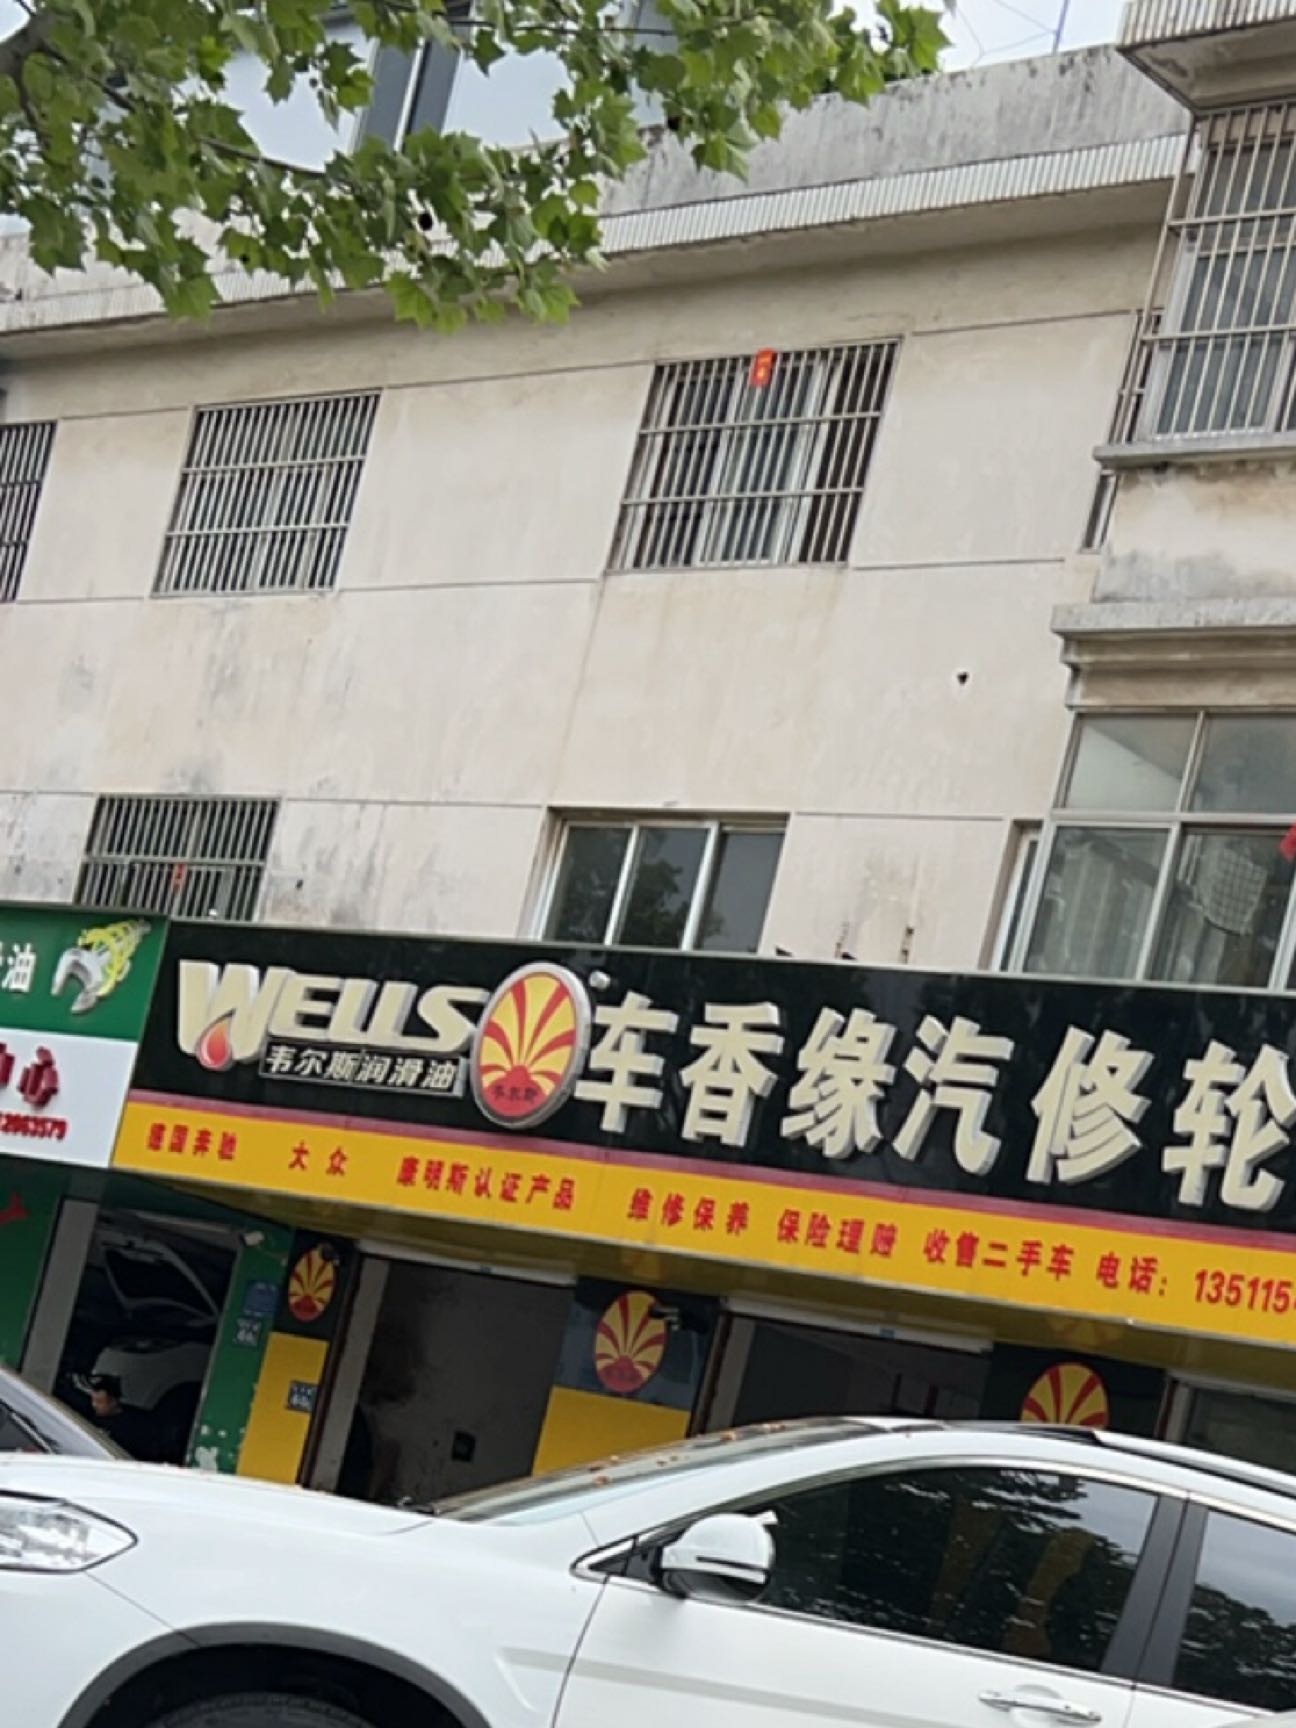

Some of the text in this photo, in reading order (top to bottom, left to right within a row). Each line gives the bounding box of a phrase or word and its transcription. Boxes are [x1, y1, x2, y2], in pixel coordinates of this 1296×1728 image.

[0, 941, 38, 994] 油
[178, 958, 491, 1066] WELLS
[266, 1045, 459, 1090] 韦尔斯润滑油
[396, 1155, 577, 1211] 康明斯认证产品
[627, 1186, 750, 1236] 维修保养
[776, 1207, 897, 1257] 保险理赔
[922, 1229, 1076, 1281] 收售二手车
